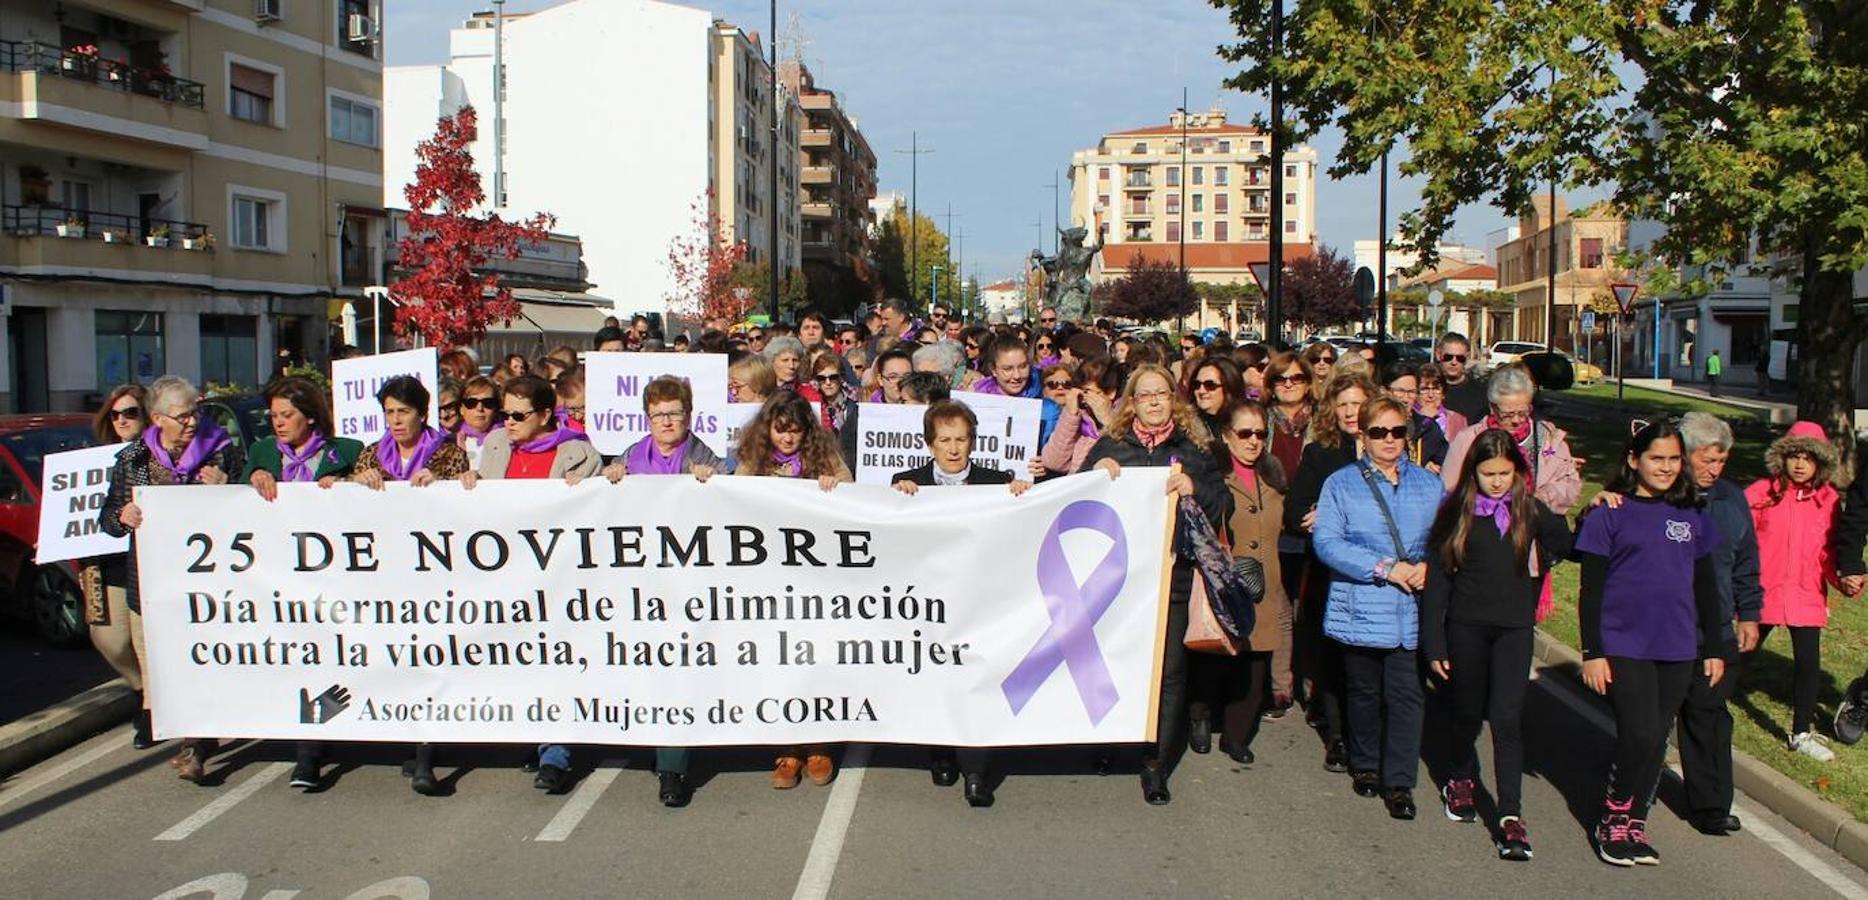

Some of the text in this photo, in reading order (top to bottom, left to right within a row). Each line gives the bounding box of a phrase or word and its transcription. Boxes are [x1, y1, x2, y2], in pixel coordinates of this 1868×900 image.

[344, 379, 364, 401] TU
[617, 375, 638, 397] NI
[342, 417, 358, 435] ES
[364, 415, 378, 433] MI
[690, 411, 718, 433] ÁS
[865, 431, 924, 449] SOMOS
[863, 453, 878, 467] DE
[881, 454, 904, 468] LAS
[51, 471, 78, 491] SI
[185, 524, 877, 573] 25 DE NOVIEMBRE
[185, 584, 947, 625] Día internacional de la eliminación
[191, 629, 970, 676] contra la violencia, hacia a la mujer
[357, 695, 880, 734] Asociación de Mujeres de CORIA
